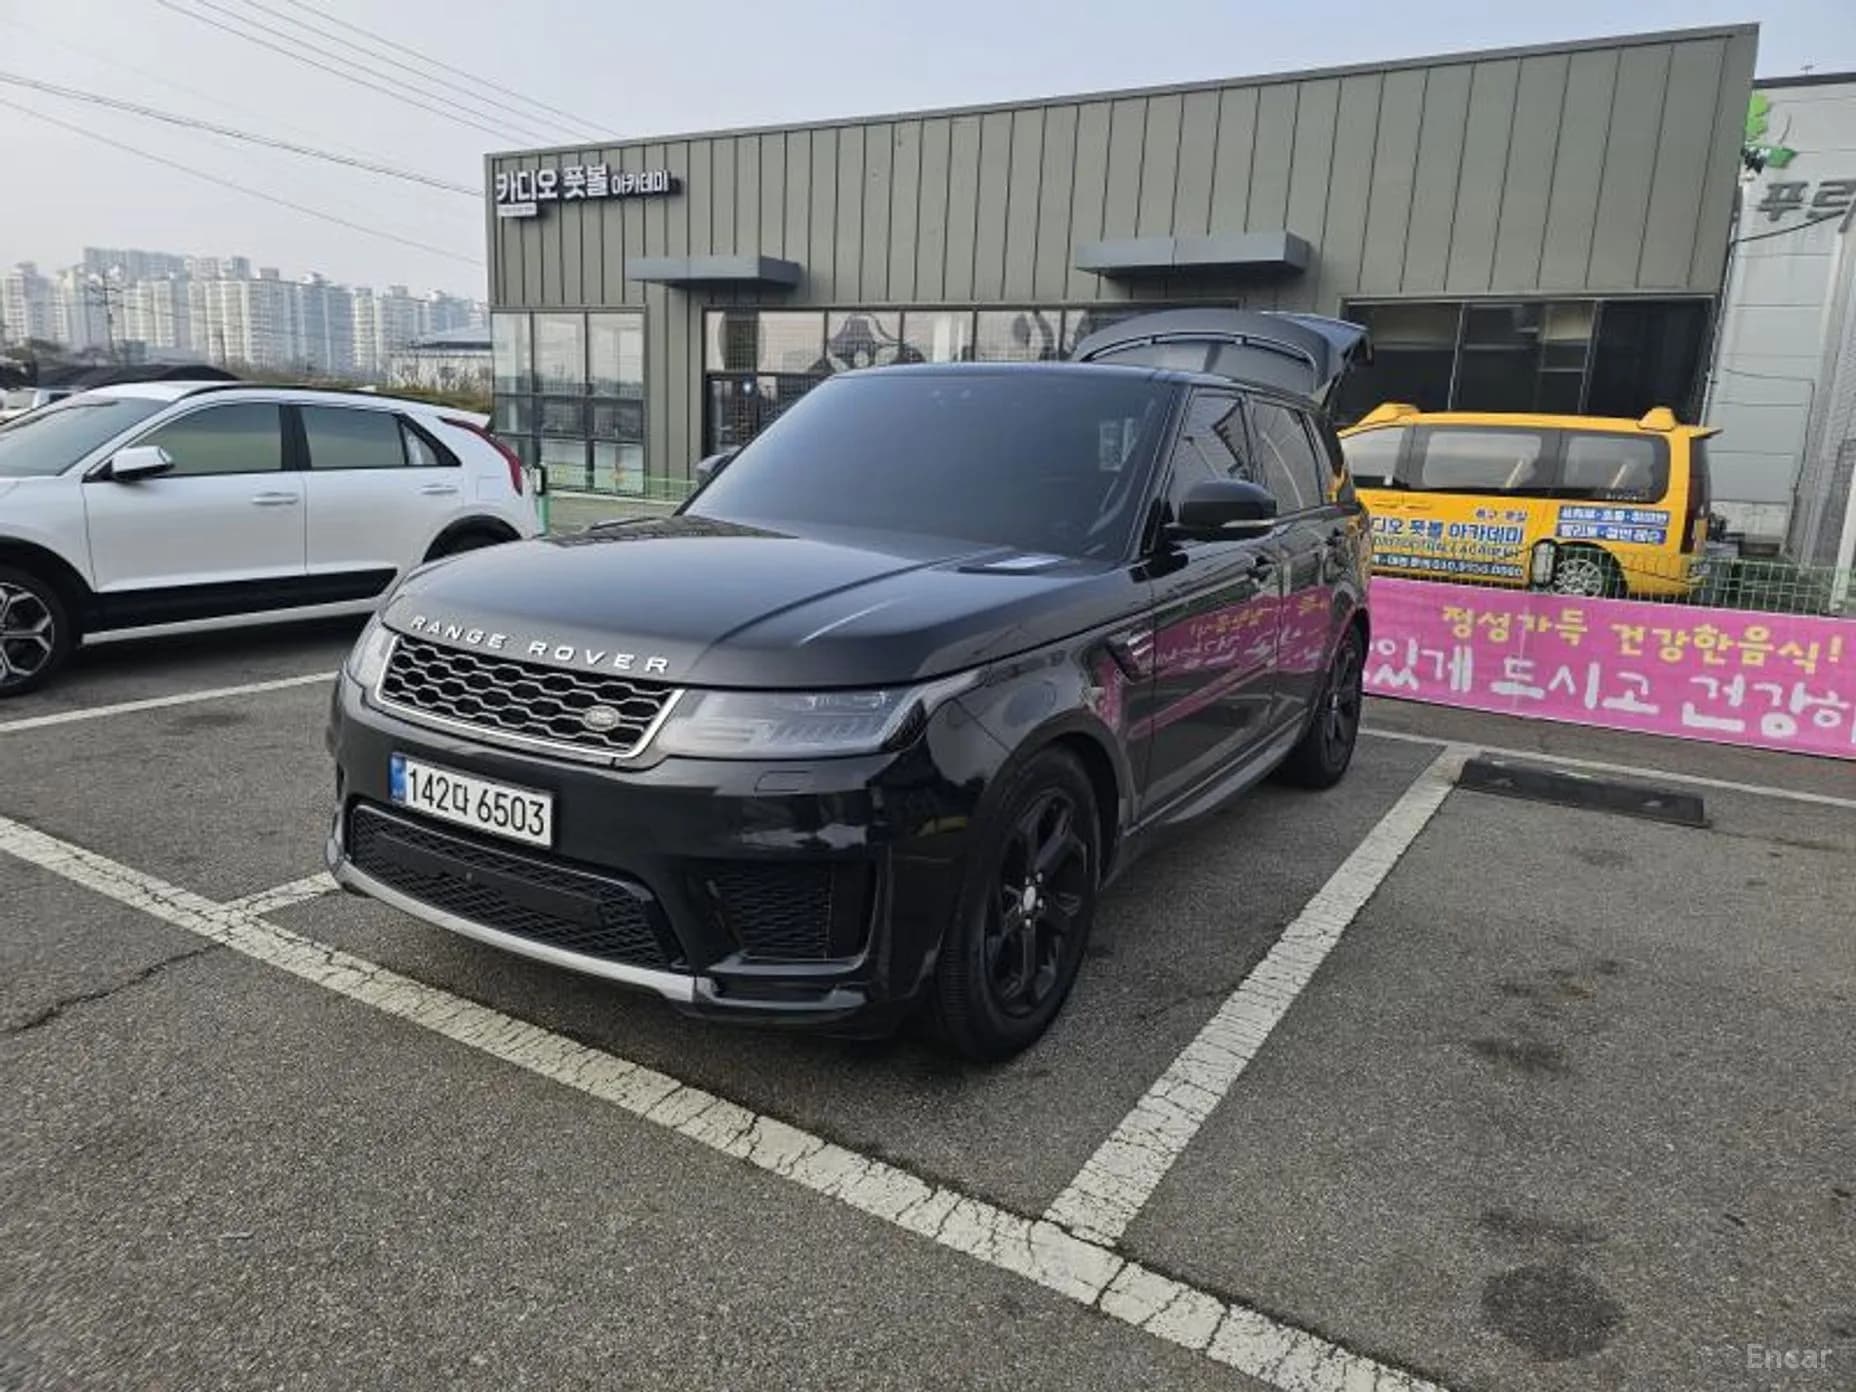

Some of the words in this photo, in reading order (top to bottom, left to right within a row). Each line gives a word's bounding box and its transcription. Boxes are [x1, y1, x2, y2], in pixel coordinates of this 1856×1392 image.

[496, 169, 557, 203] 카디오
[564, 164, 609, 199] 풋볼
[611, 170, 670, 195] 아카데미
[1371, 517, 1402, 535] 디오
[1449, 522, 1524, 544] 아카데미
[410, 615, 508, 649] RANGE
[528, 640, 669, 674] ROVER
[1442, 606, 1588, 646] 정성가득
[1611, 623, 1843, 674] 건강한음식!
[1362, 637, 1473, 693] 있게
[1490, 656, 1660, 713] 드시고
[408, 768, 470, 816] 142다
[477, 788, 545, 836] 6503
